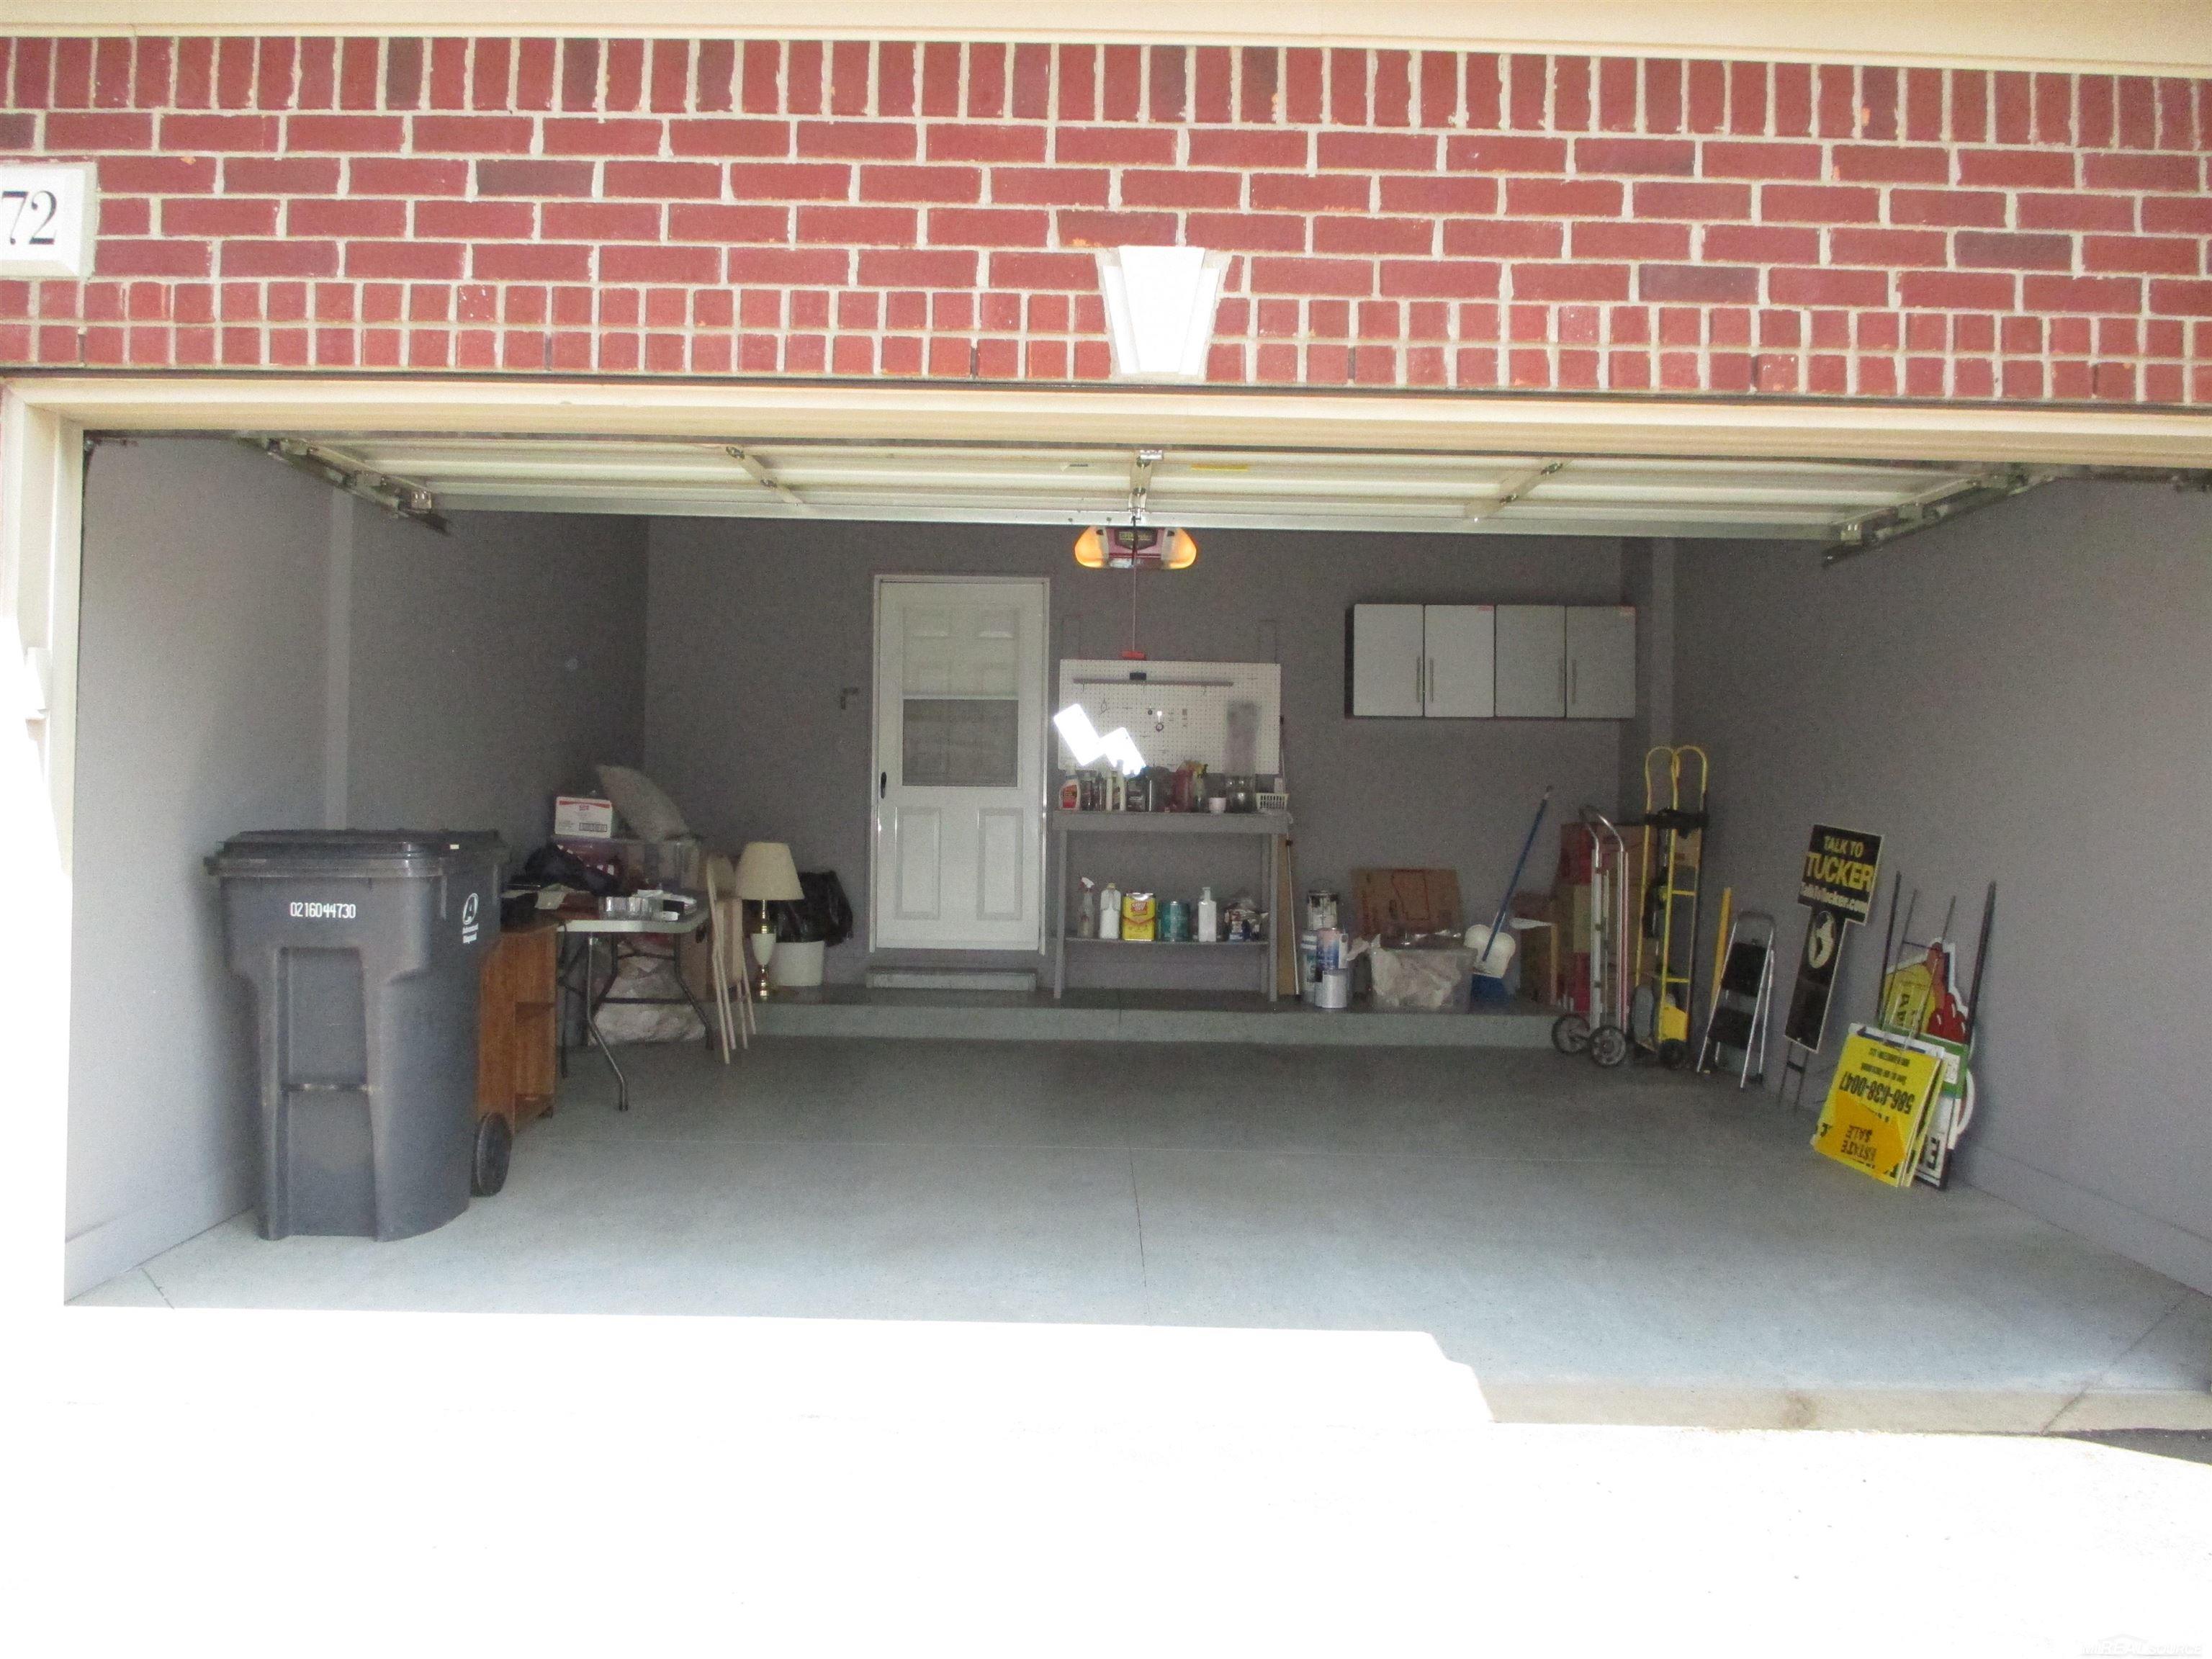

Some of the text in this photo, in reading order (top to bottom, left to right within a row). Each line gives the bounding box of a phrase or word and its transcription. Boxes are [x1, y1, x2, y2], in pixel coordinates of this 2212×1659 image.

[2, 189, 57, 245] 72
[1825, 836, 1864, 858] TALK TO
[1806, 852, 1874, 892] TUCKER
[289, 902, 356, 919] 0216044730
[1845, 1125, 1873, 1143] SALE
